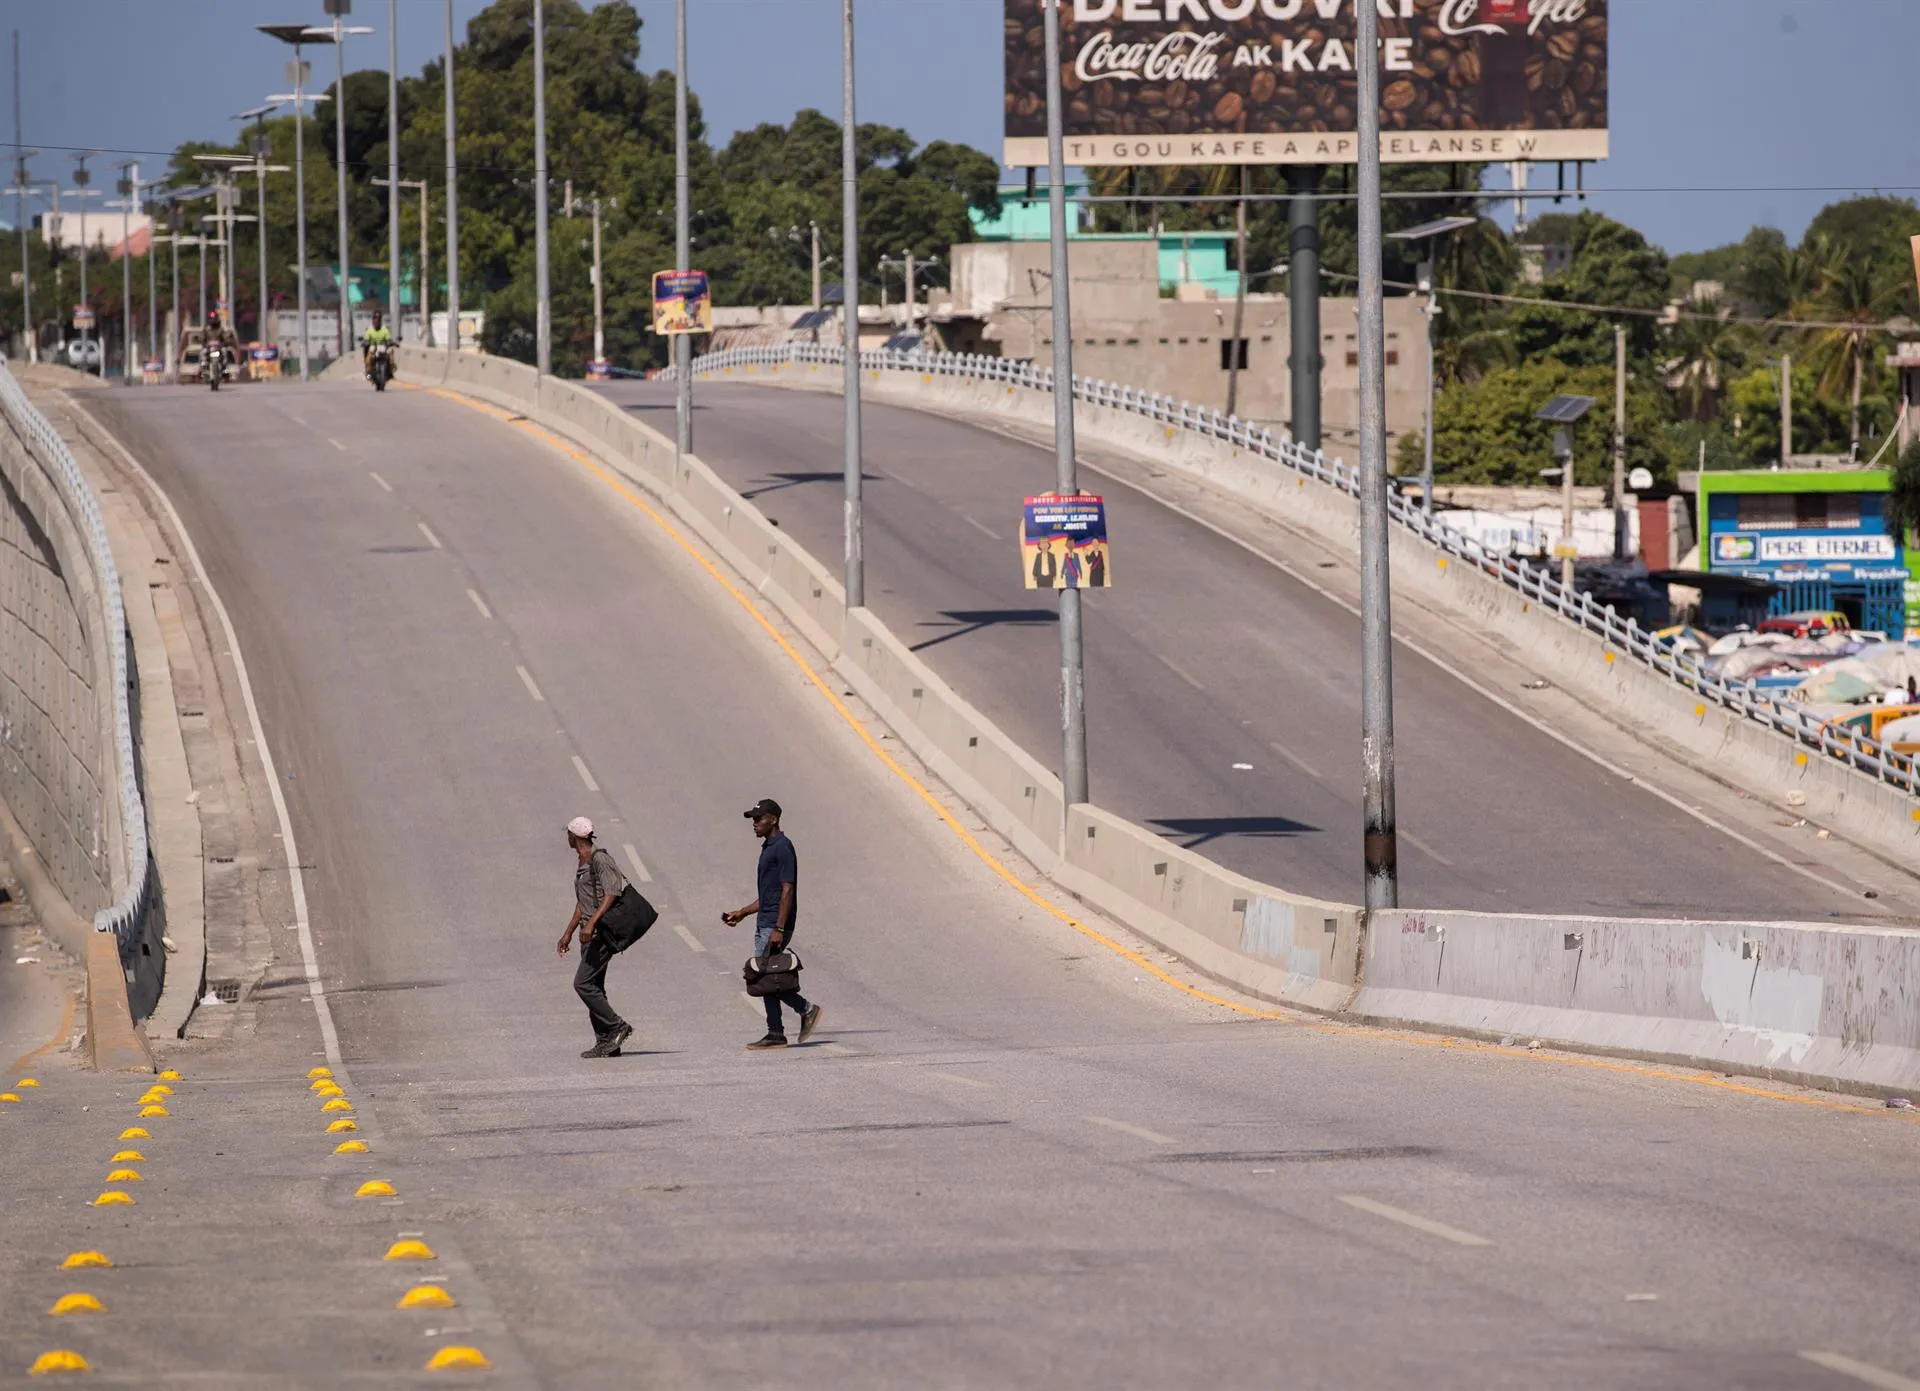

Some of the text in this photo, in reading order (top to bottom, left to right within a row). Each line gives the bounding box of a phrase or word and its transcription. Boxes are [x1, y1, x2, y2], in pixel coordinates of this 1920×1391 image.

[1073, 0, 1414, 22] DEKOUVI
[1075, 32, 1414, 82] Coca-Cola AK KAE
[1071, 142, 1096, 157] TI
[1112, 142, 1171, 157] GOU
[1191, 141, 1266, 157] KAFE
[1284, 140, 1297, 154] A
[1379, 138, 1504, 154] ELANSE
[1517, 138, 1537, 153] W
